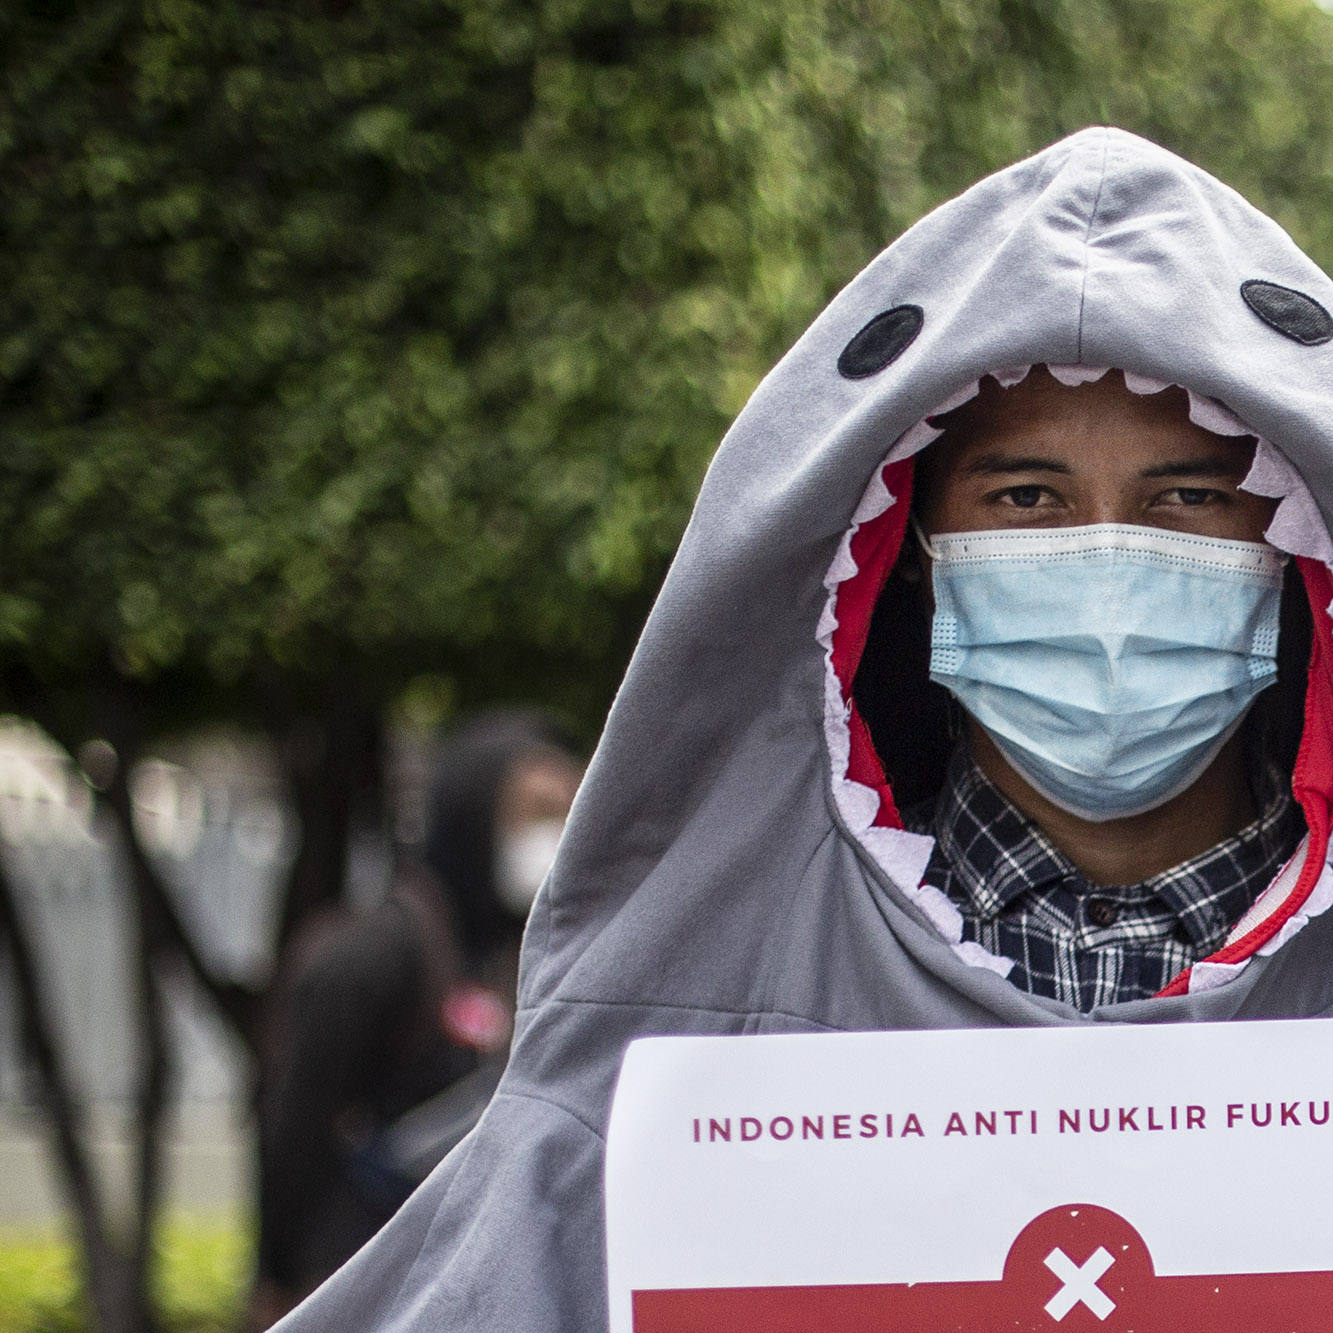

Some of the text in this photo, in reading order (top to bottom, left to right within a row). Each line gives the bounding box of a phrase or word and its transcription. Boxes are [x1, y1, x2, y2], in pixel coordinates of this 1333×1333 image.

[693, 1113, 925, 1143] INDONESIA
[943, 1110, 1037, 1137] ANTI
[1059, 1105, 1206, 1134] NUKLIR
